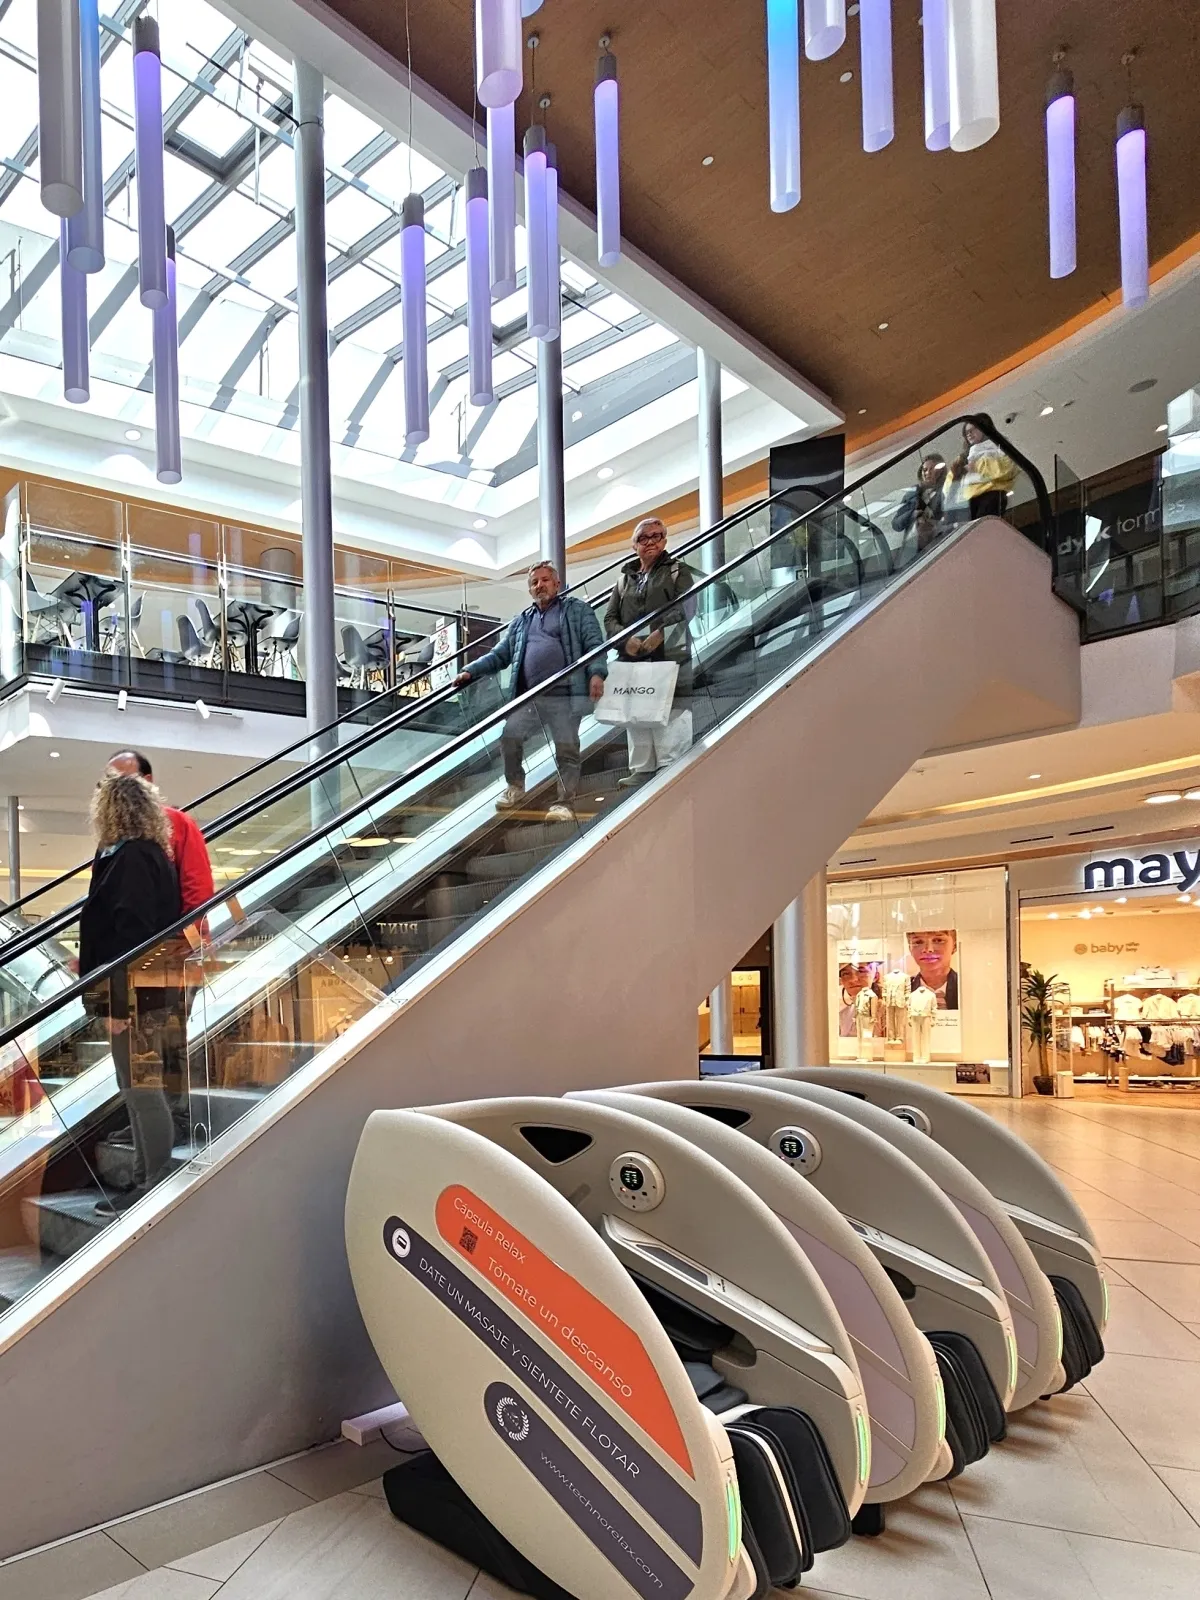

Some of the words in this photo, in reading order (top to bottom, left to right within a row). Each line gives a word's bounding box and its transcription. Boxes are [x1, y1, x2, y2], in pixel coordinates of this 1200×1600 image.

[613, 686, 656, 696] MANGO
[1083, 848, 1200, 892] may
[1090, 942, 1125, 955] baby
[453, 1197, 494, 1237] Cápsula
[494, 1230, 527, 1265] Relax
[487, 1256, 538, 1308] Tómate
[539, 1304, 560, 1328] un
[561, 1325, 633, 1398] descanso
[419, 1257, 447, 1289] DATE
[447, 1282, 464, 1305] UN
[464, 1300, 510, 1350] MASAJE
[511, 1343, 521, 1357] Y
[519, 1354, 583, 1420] SIENTETE
[581, 1416, 640, 1479] FLOTAR
[540, 1450, 664, 1589] www.technorelax.com
